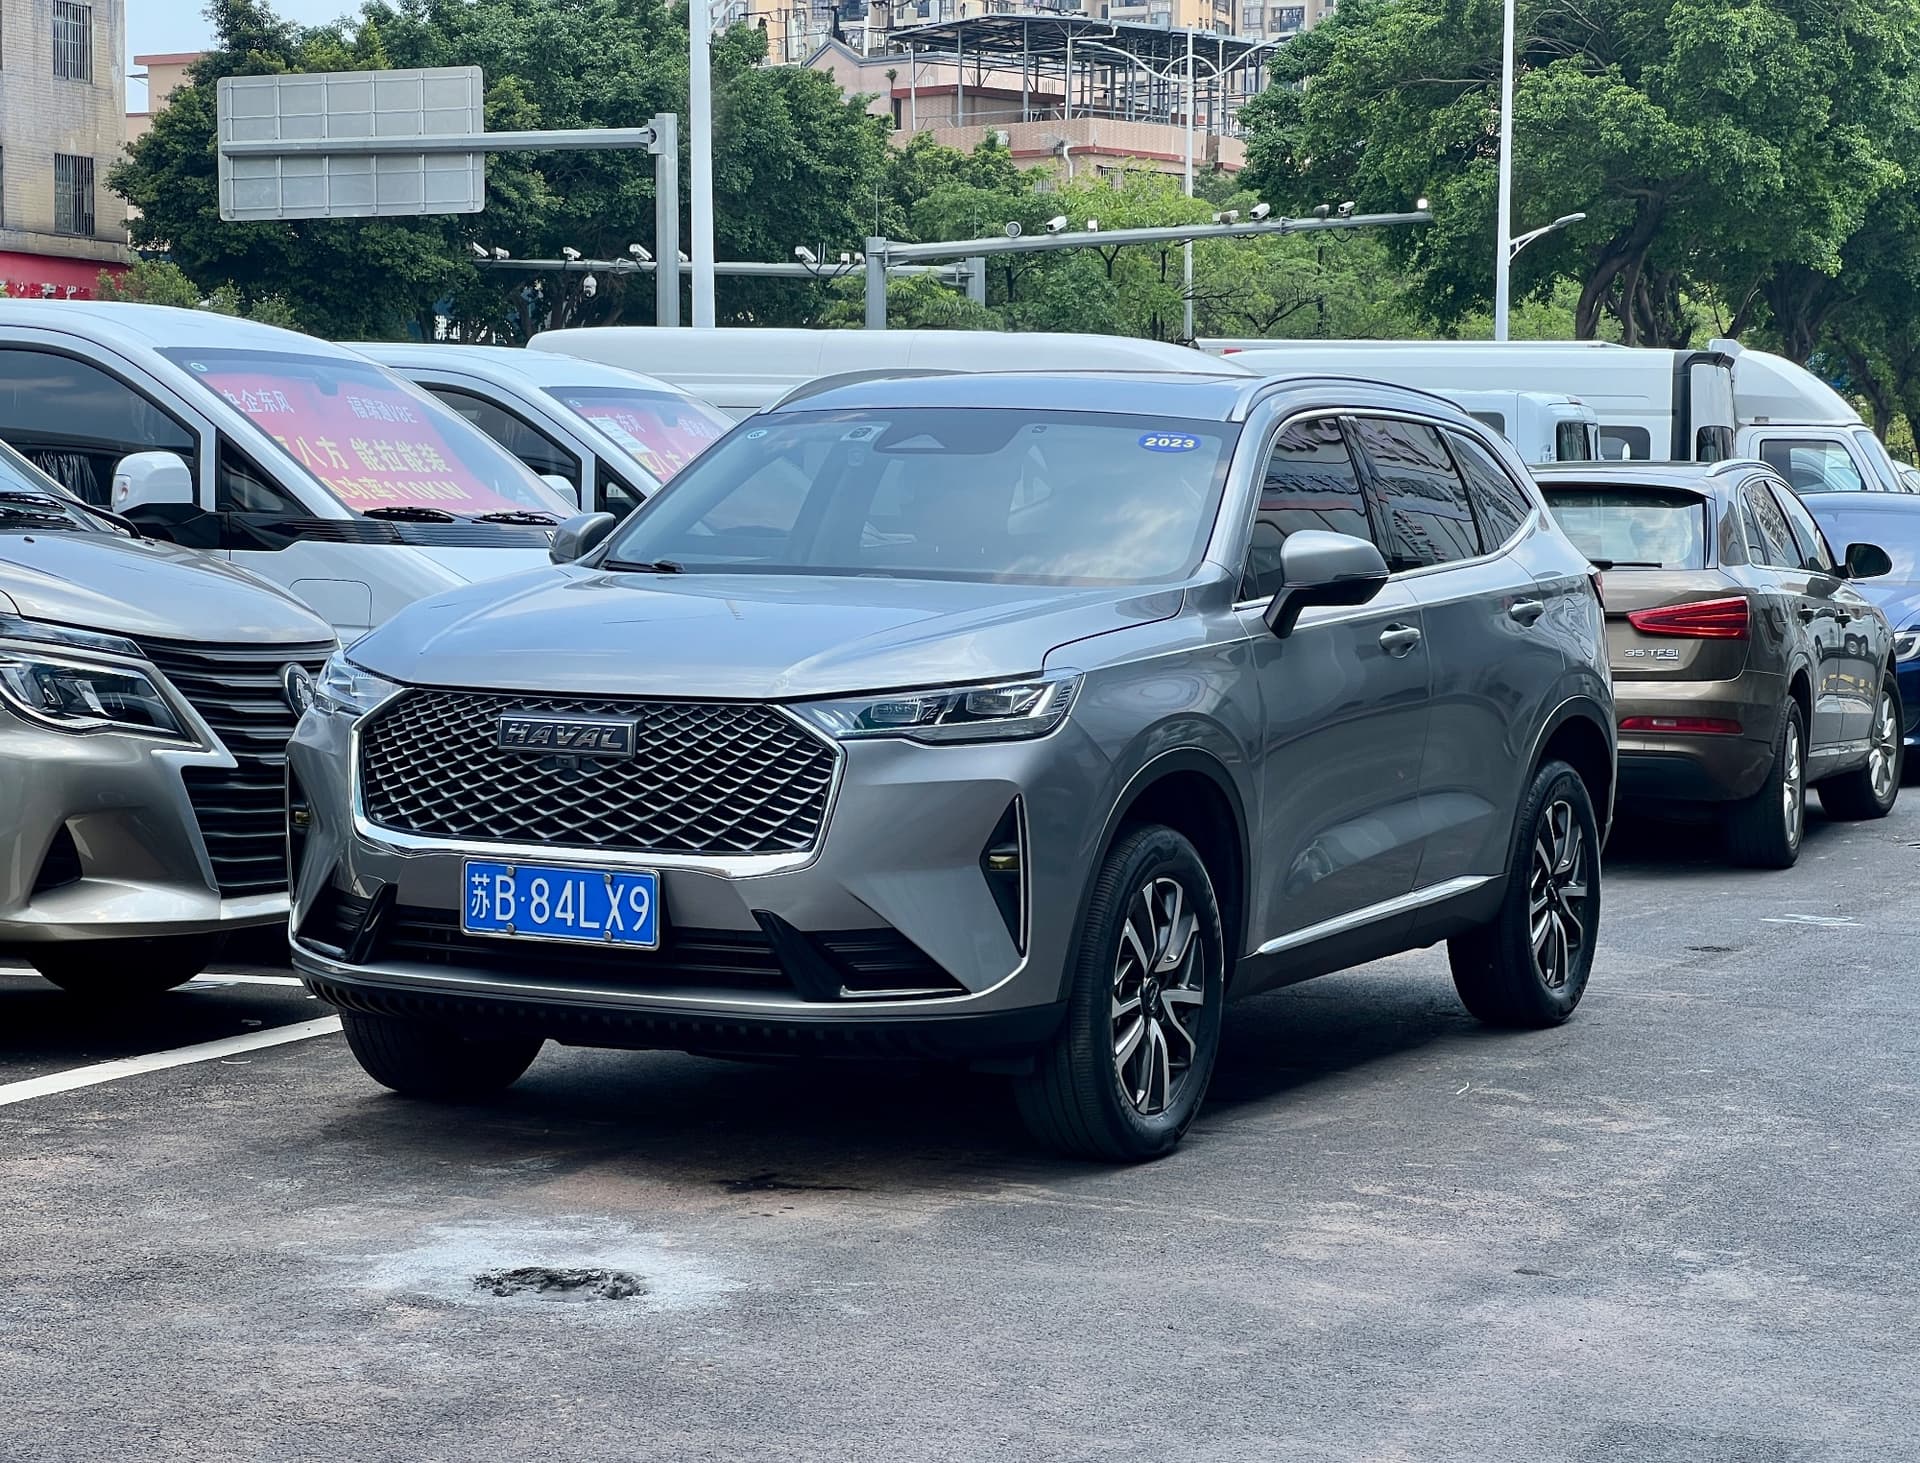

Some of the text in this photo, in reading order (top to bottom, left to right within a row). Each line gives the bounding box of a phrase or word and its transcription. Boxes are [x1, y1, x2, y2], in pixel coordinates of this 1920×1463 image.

[273, 435, 350, 470] 八方
[1144, 437, 1196, 449] 2023
[1624, 648, 1679, 658] 35 TFSI
[505, 722, 623, 749] HAVAL
[471, 872, 650, 933] 苏B·84LX9
